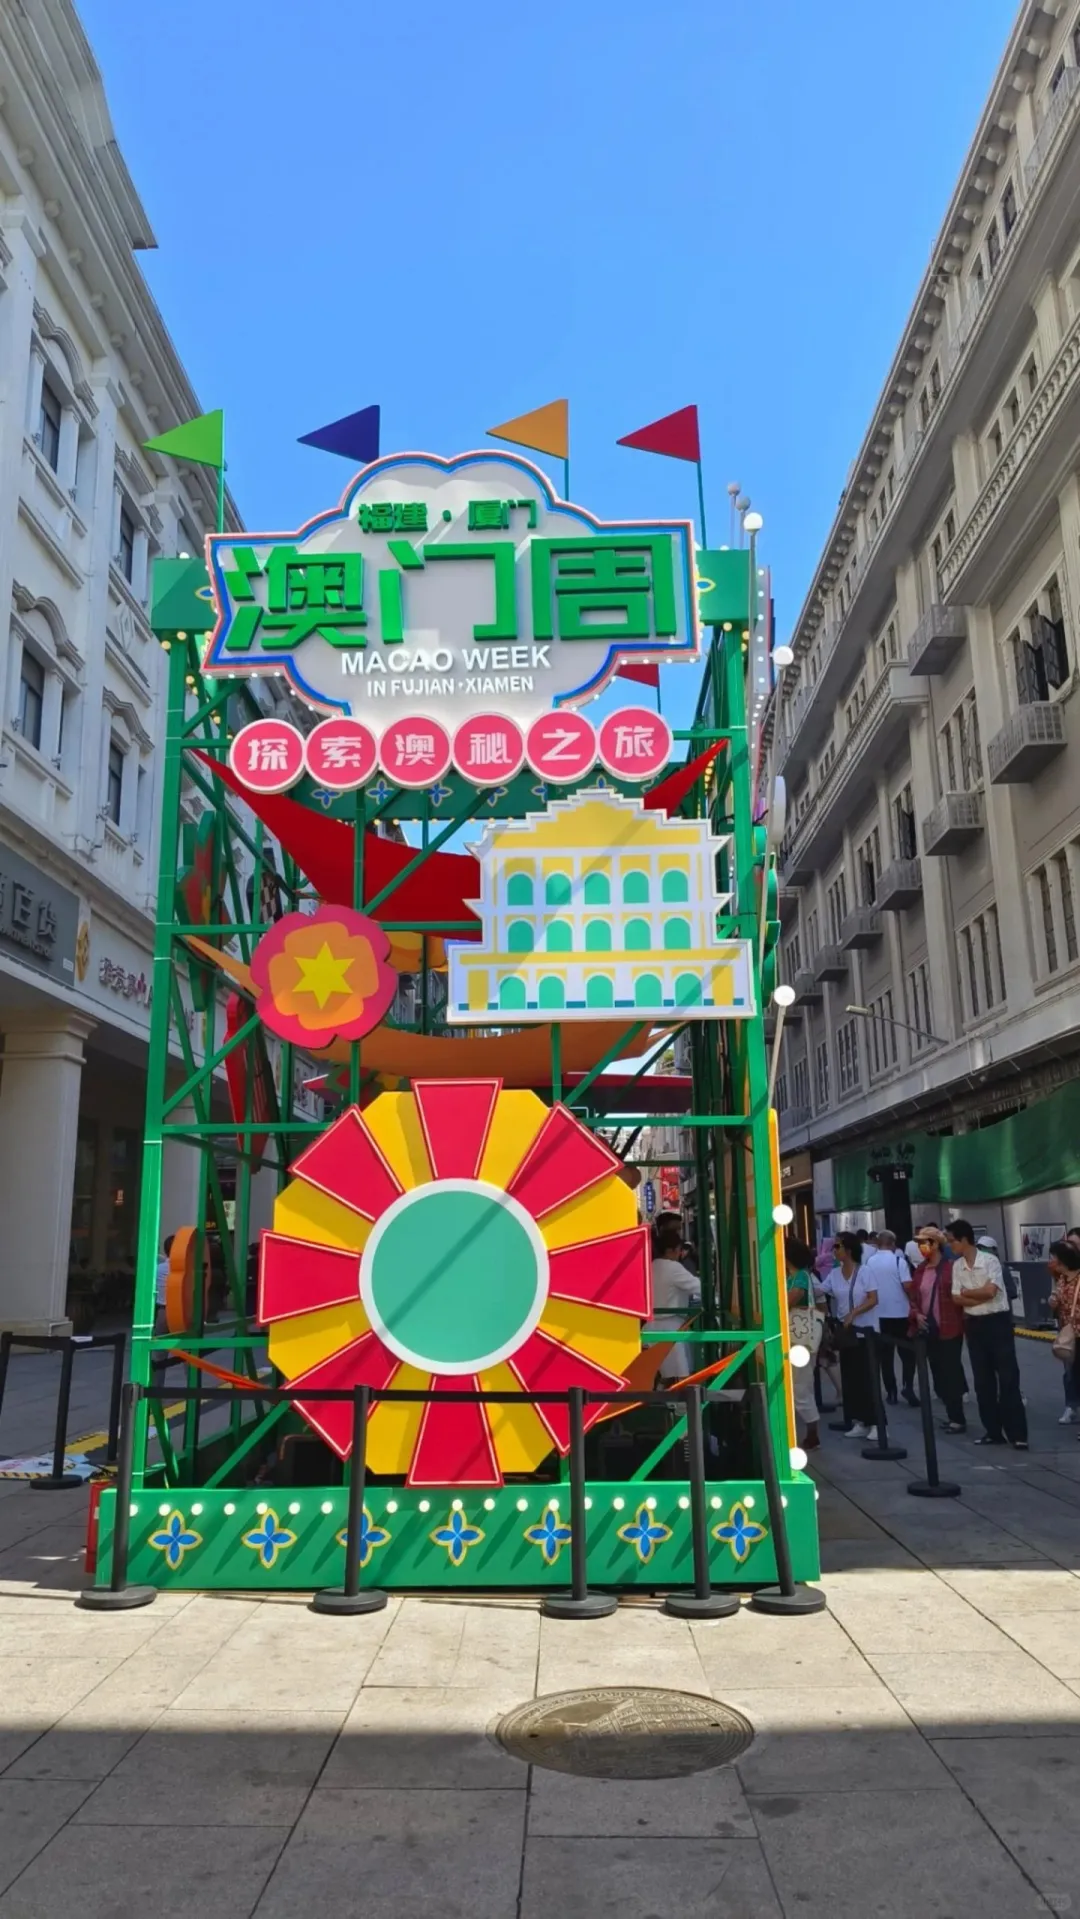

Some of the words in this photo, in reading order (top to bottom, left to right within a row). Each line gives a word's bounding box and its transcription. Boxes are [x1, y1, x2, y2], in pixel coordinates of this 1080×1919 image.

[225, 534, 677, 651] 澳门周
[341, 650, 453, 675] MACAO
[462, 645, 551, 670] WEEK
[367, 680, 386, 697] IN
[247, 723, 655, 773] 探索澳秘之旅
